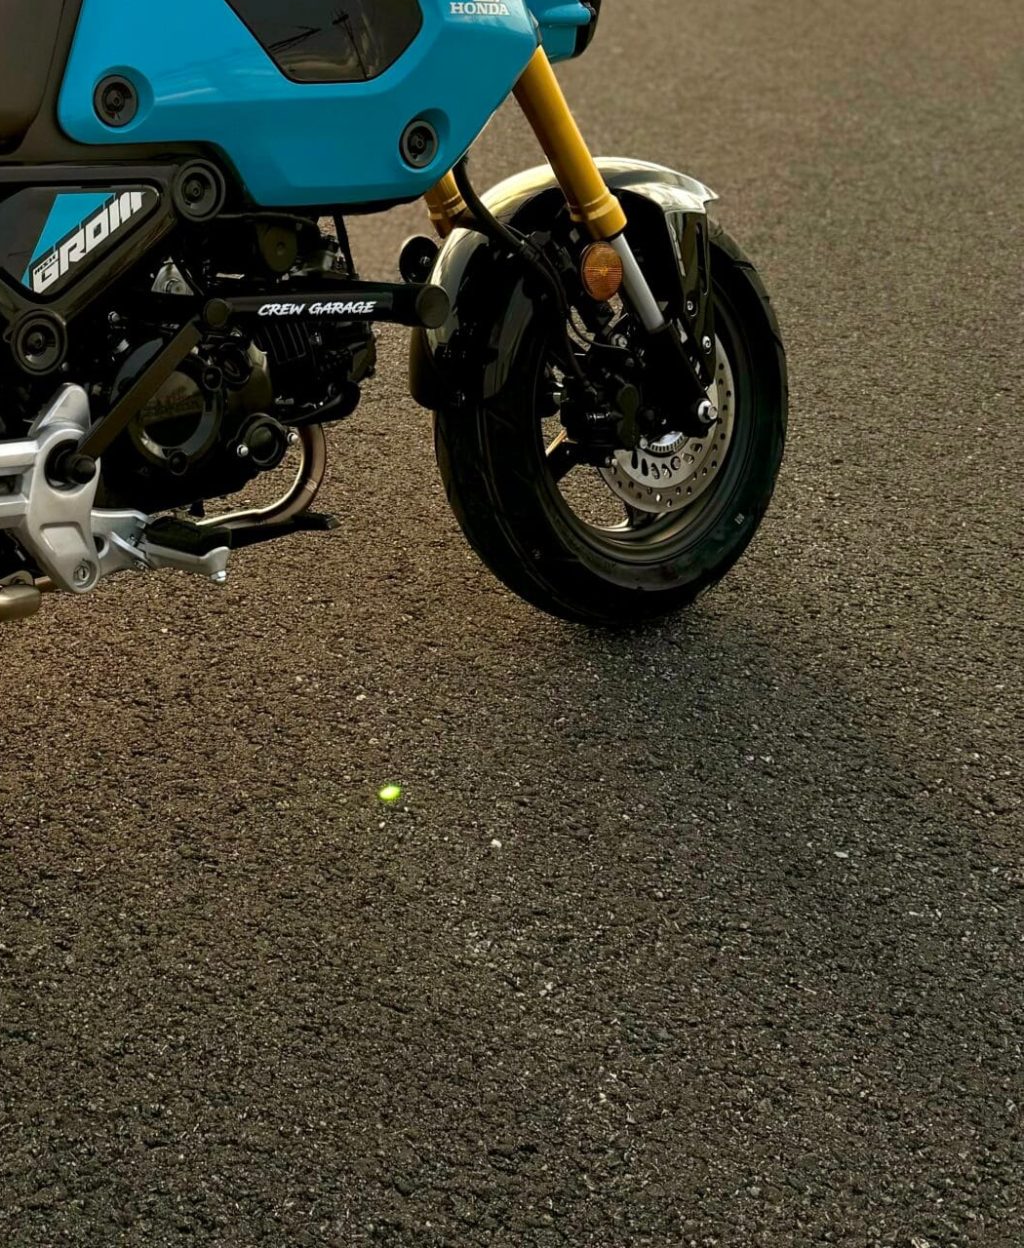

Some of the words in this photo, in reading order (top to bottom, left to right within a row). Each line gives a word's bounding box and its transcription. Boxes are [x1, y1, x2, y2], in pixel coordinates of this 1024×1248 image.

[449, 2, 510, 16] HONDA
[32, 191, 146, 295] GROM
[257, 303, 306, 316] CREW
[308, 301, 377, 315] GARAGE
